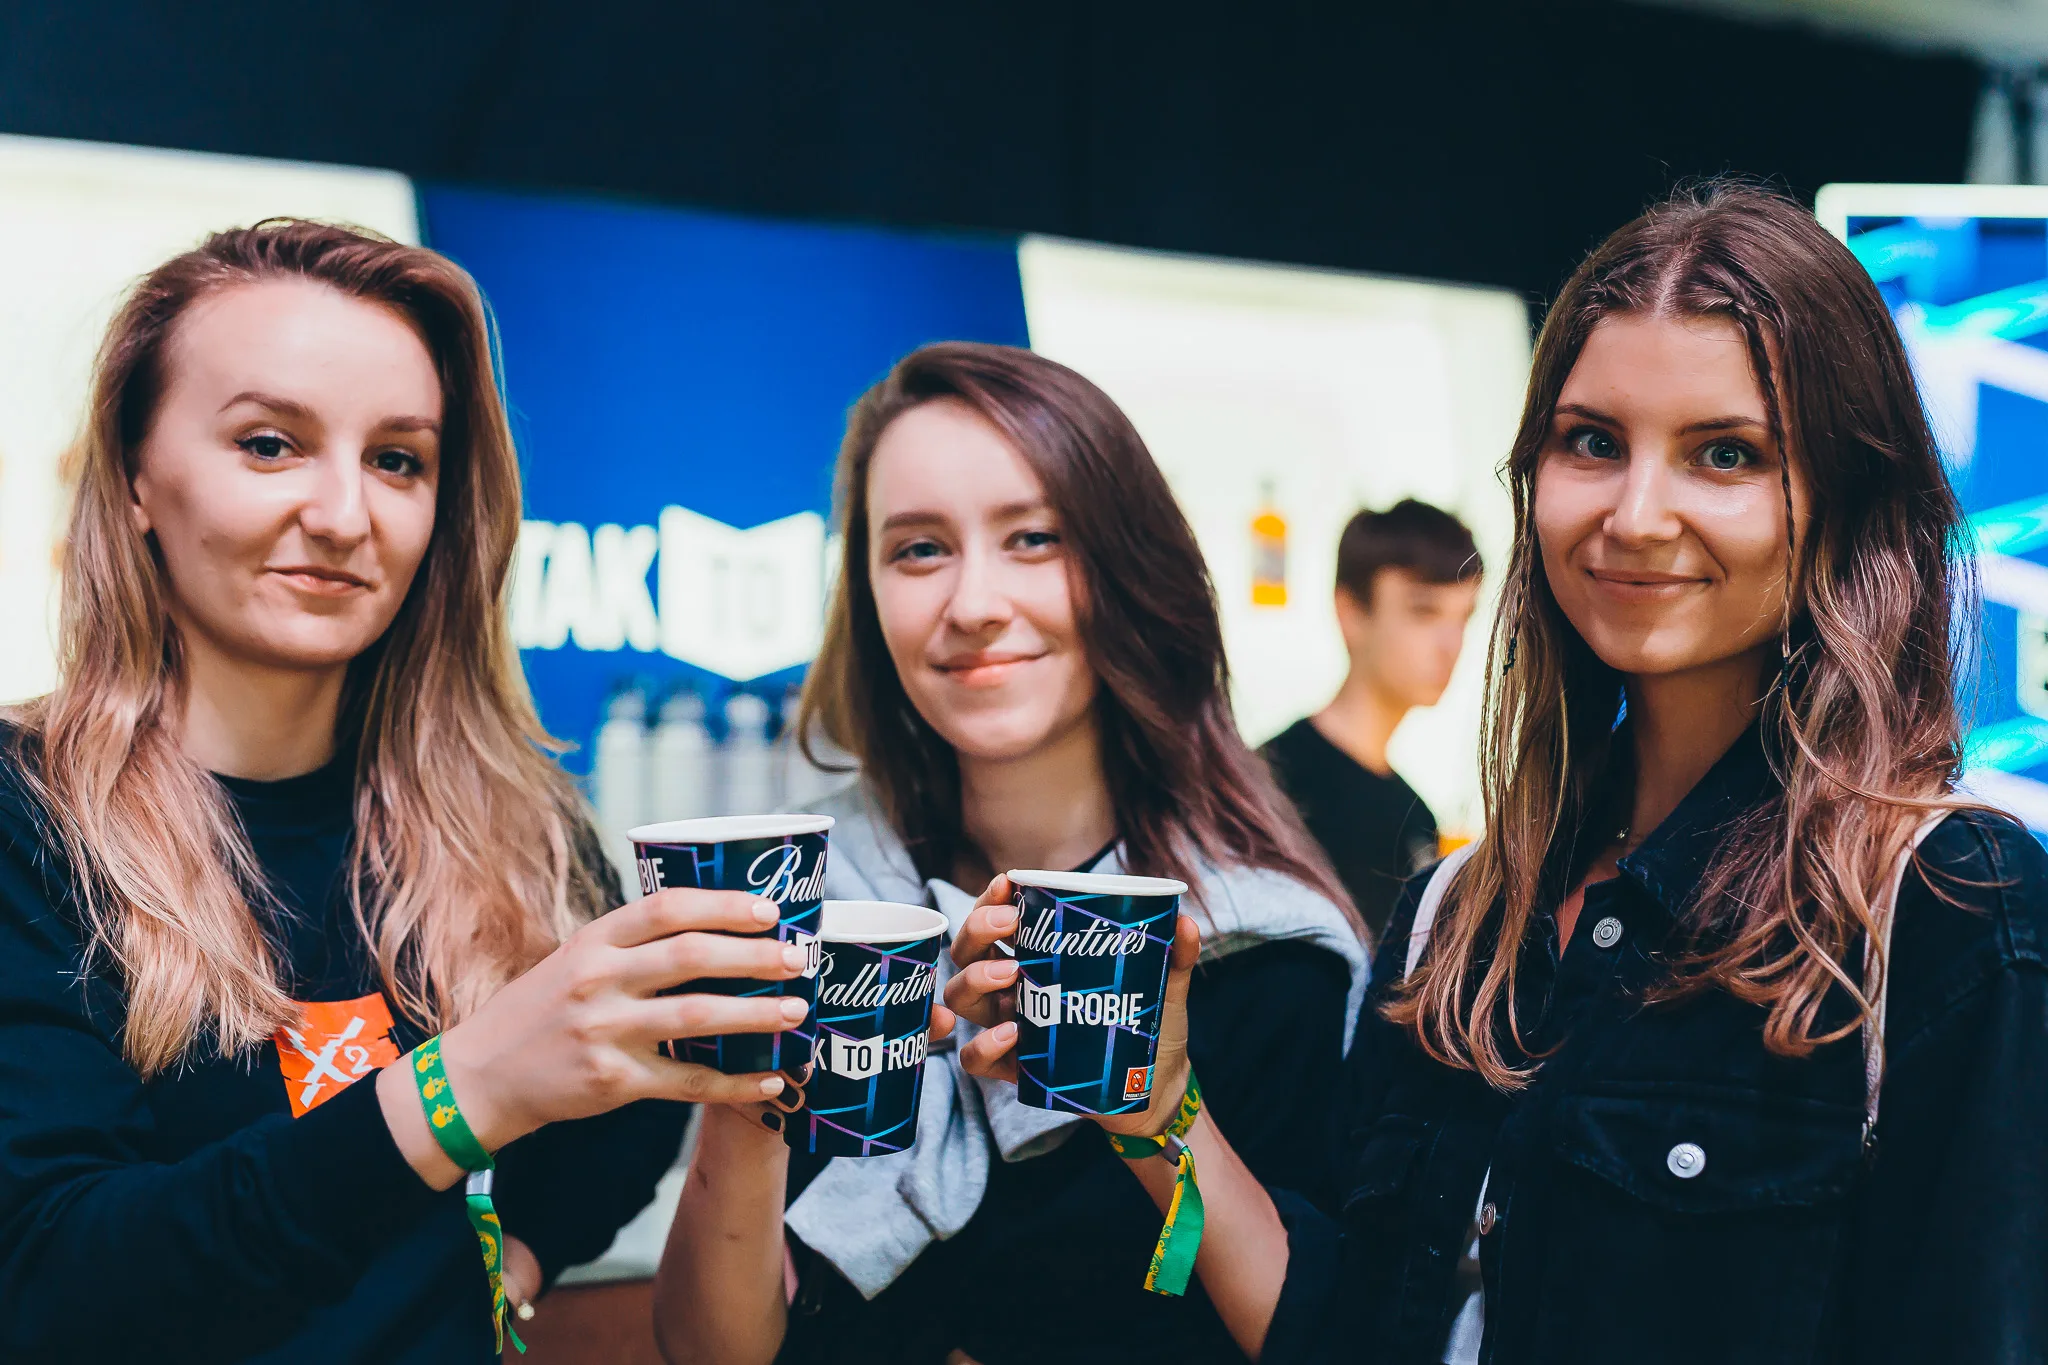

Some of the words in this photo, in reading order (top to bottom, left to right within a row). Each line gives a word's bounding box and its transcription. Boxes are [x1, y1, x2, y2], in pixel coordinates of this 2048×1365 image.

[805, 940, 819, 970] TO
[1030, 990, 1051, 1019] TO
[1066, 991, 1144, 1035] ROBIĘ
[842, 1045, 872, 1072] TO
